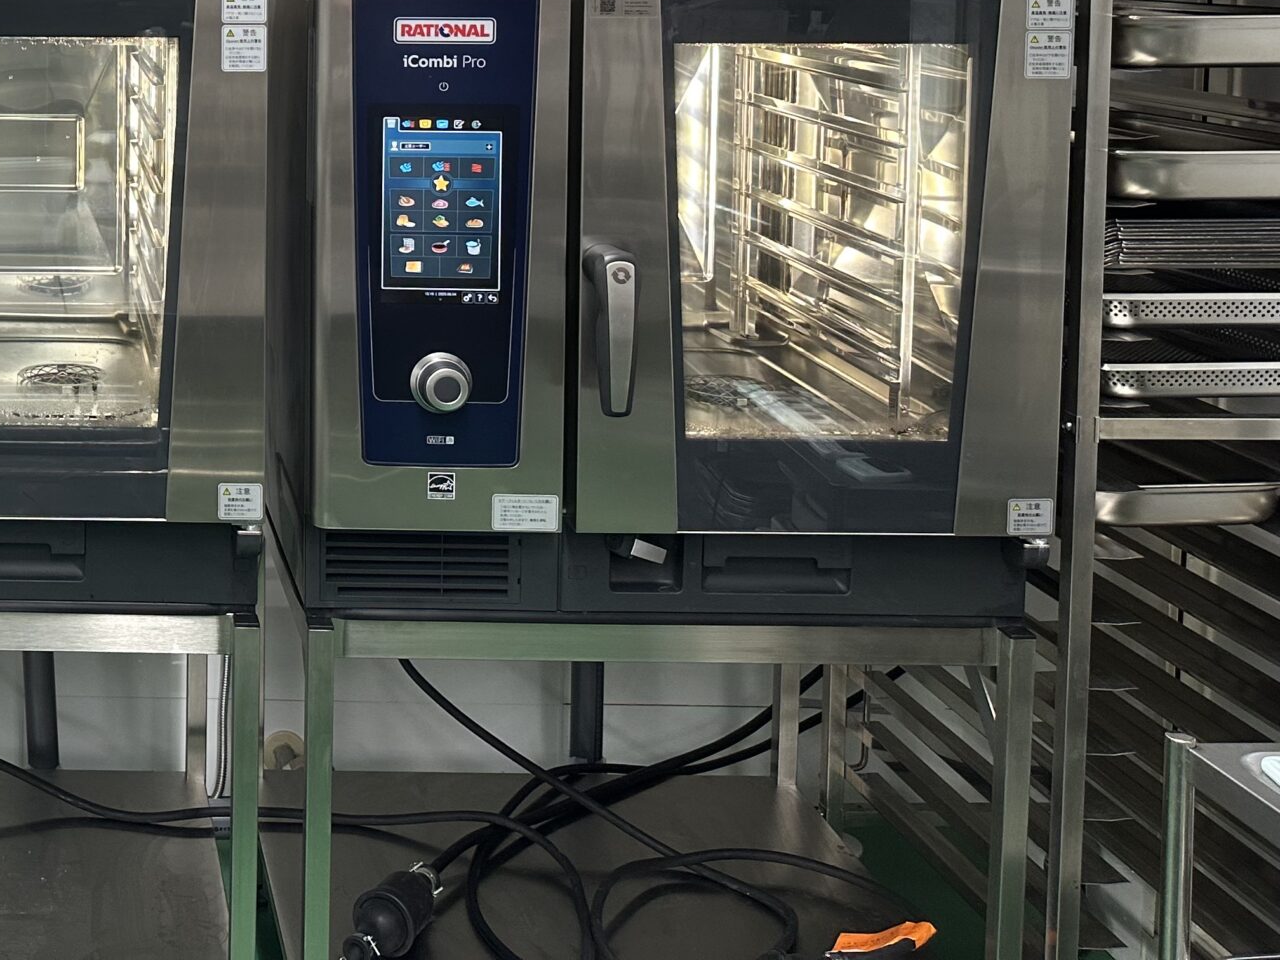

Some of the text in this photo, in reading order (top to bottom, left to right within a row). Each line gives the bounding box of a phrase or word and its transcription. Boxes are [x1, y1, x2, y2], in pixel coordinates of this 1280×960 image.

[400, 23, 490, 38] RATIONAL
[403, 55, 487, 68] iCombi Pro
